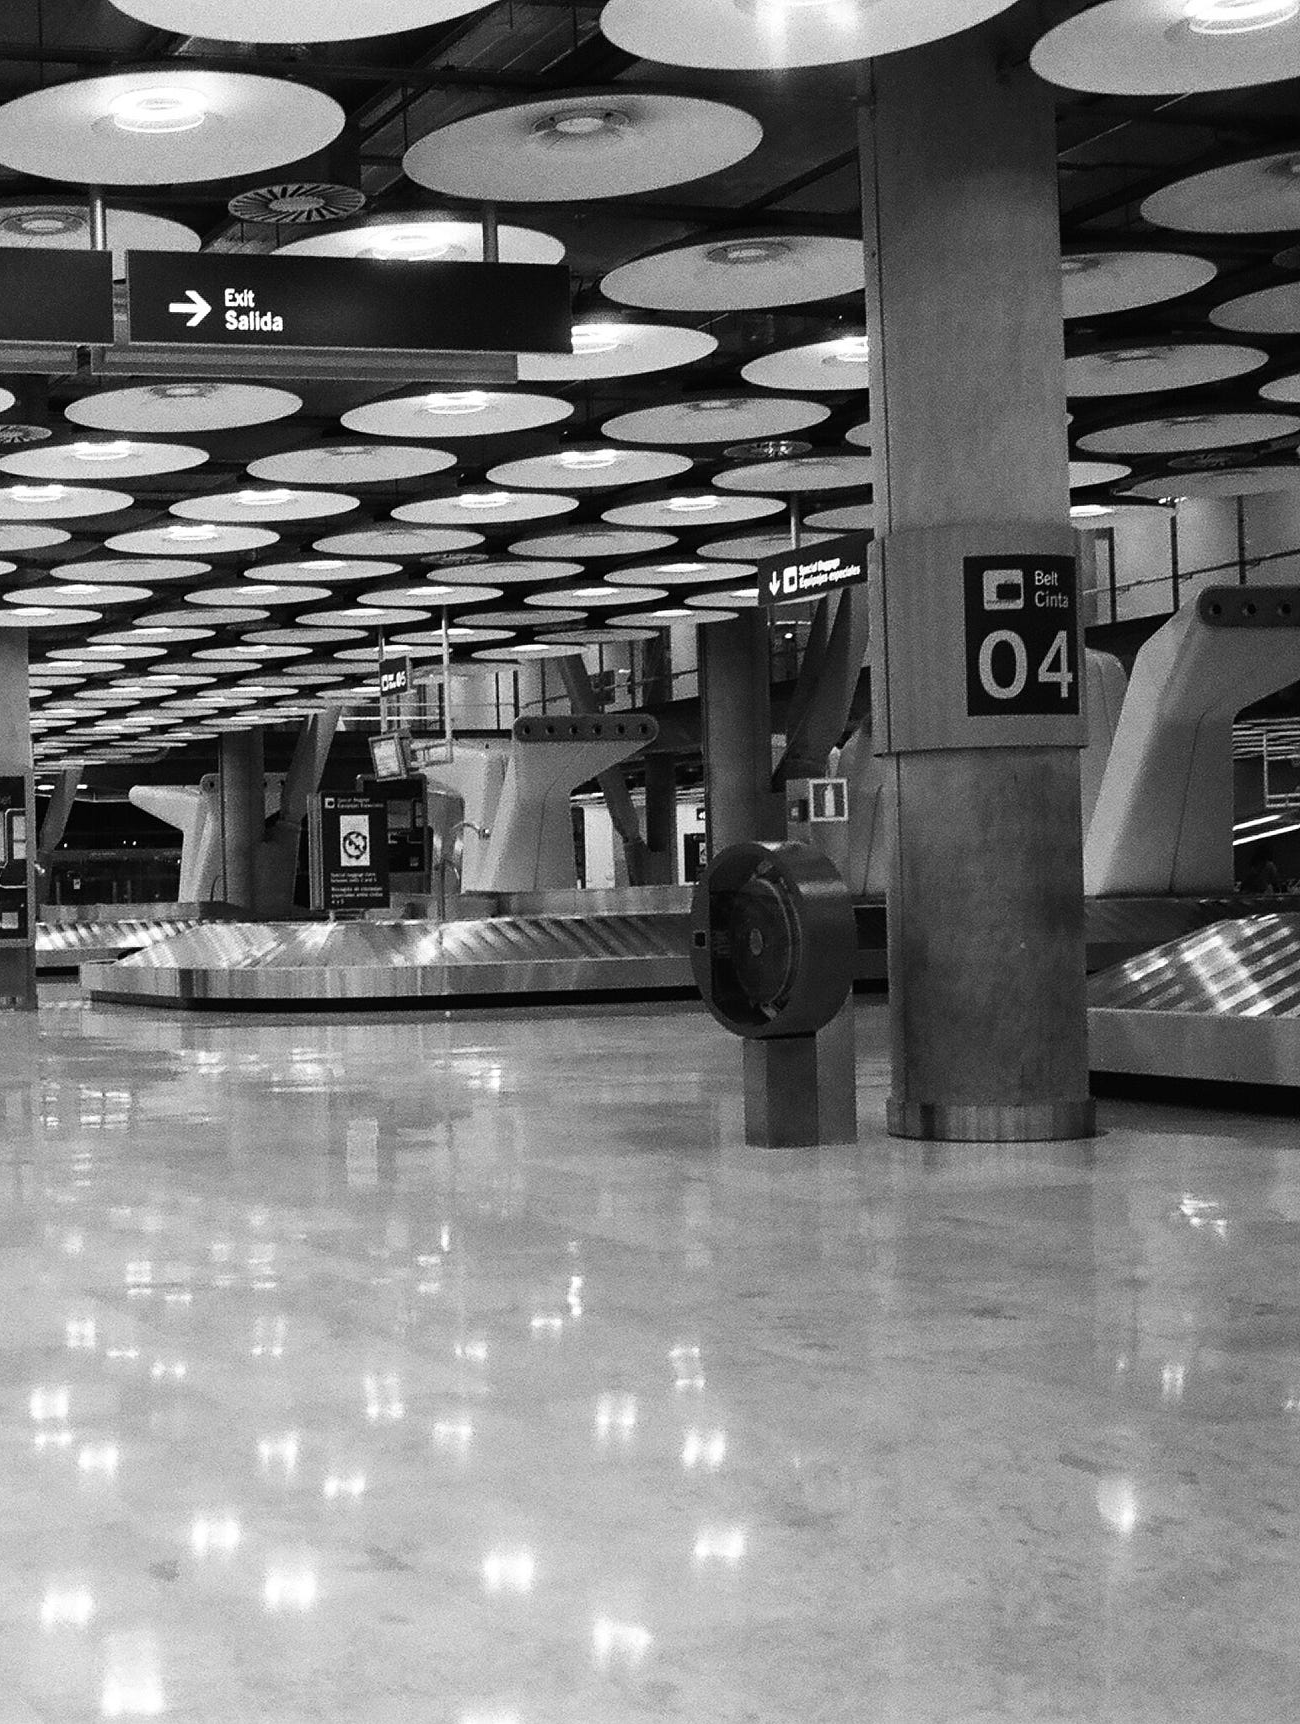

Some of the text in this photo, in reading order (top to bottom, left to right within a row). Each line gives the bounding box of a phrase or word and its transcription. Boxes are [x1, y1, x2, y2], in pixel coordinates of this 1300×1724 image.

[225, 288, 255, 308] Exit
[225, 310, 283, 331] Salida
[1035, 570, 1059, 586] Belt
[1035, 591, 1069, 608] Cinta
[979, 629, 1073, 699] 04
